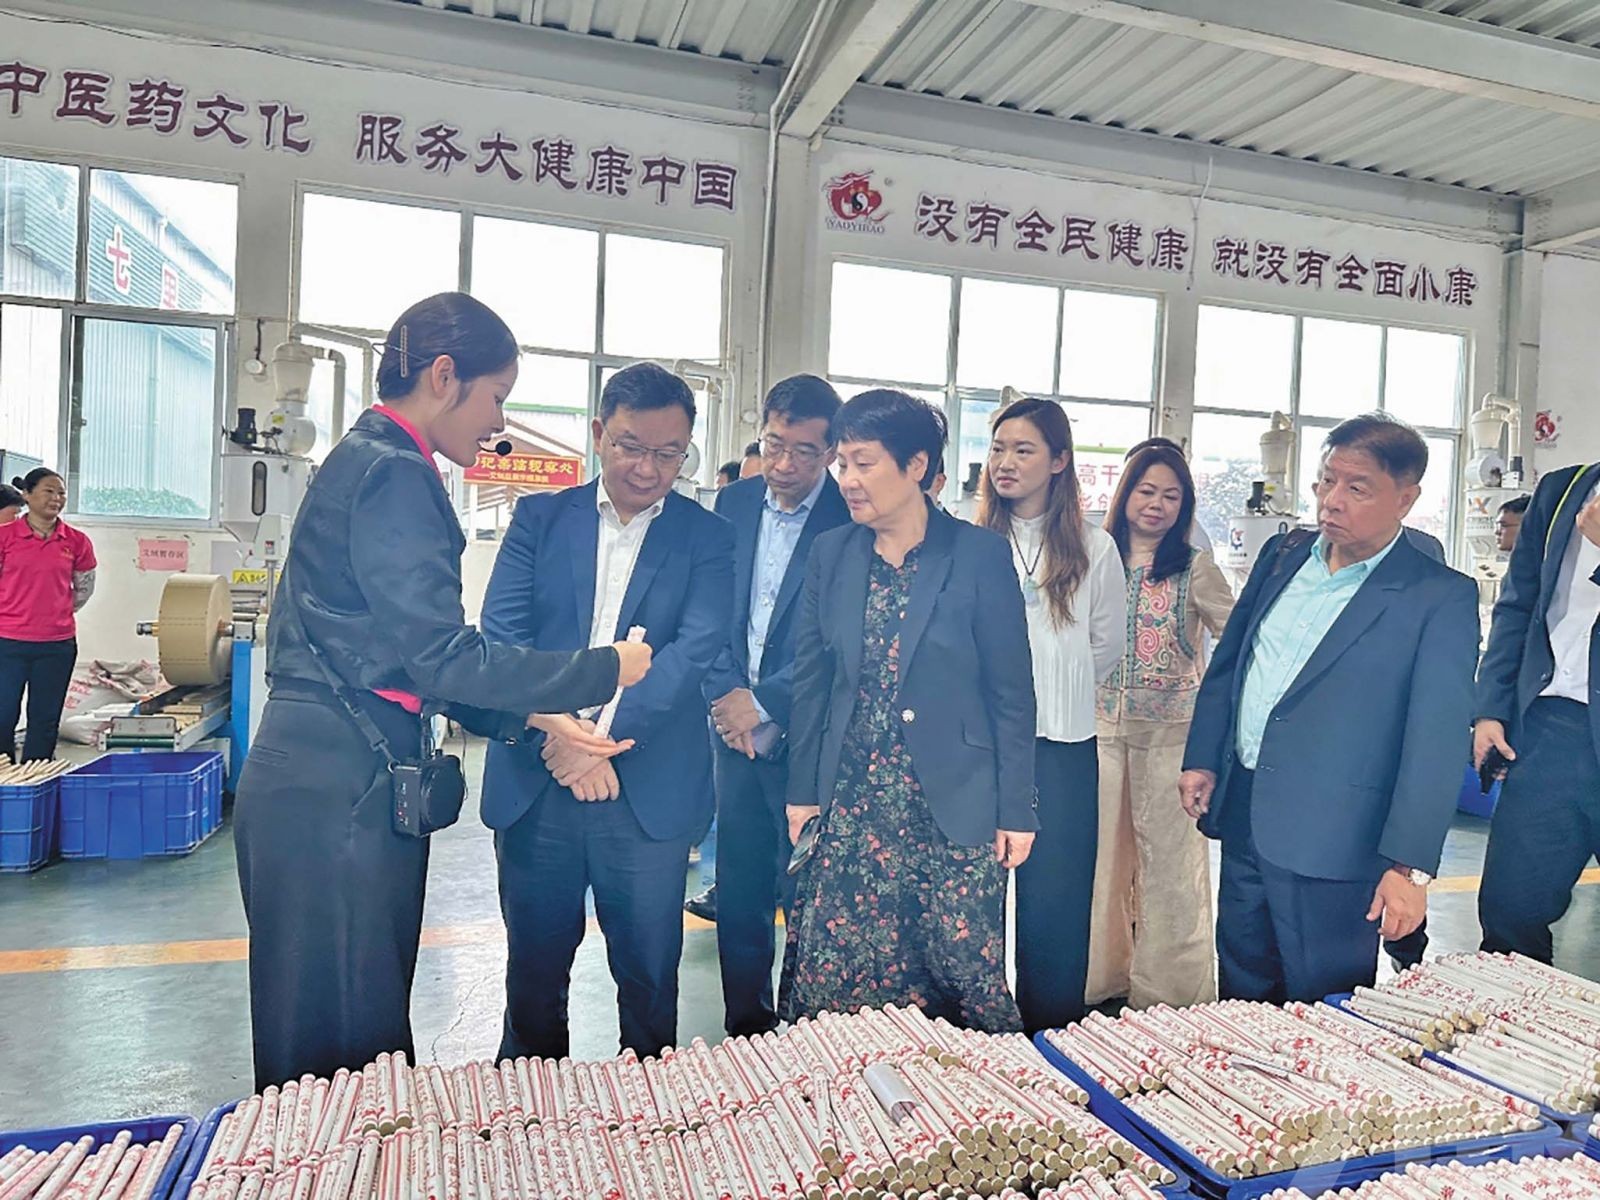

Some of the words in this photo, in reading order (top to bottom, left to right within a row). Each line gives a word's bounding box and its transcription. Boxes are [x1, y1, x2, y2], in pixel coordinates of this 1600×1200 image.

[0, 61, 311, 151] 中医药文化
[356, 114, 737, 210] 服务大健康中国
[917, 195, 1189, 271] 没有全民健康
[1214, 237, 1477, 306] 就没有全面小康
